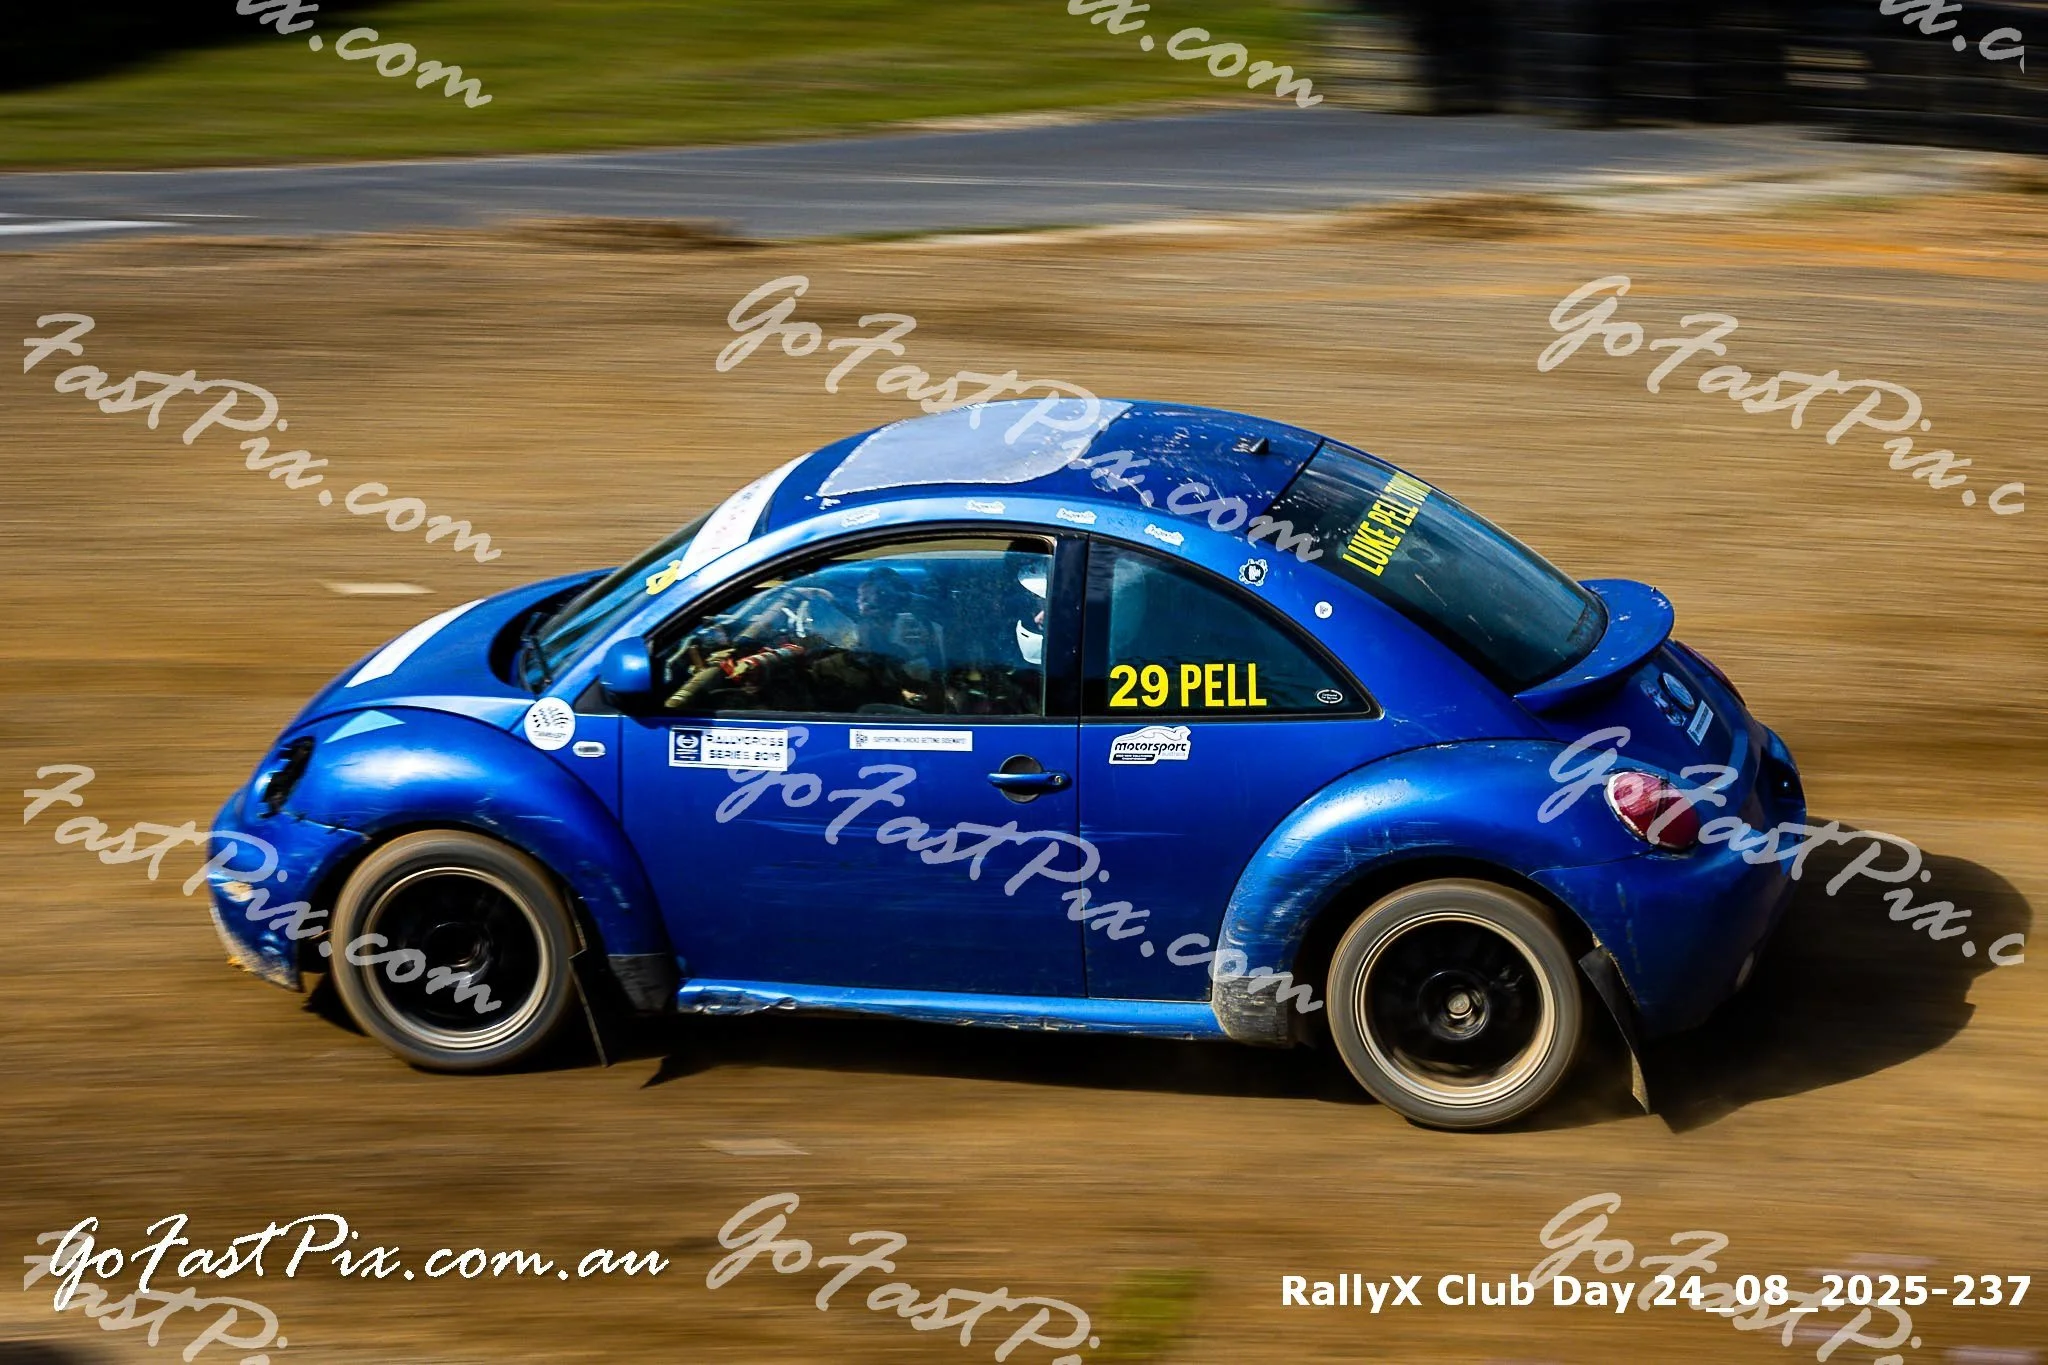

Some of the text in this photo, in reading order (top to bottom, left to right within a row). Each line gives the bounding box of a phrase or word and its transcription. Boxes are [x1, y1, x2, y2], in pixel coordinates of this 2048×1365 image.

[1367, 493, 1419, 535] PELL
[1342, 520, 1402, 577] LUKE
[1109, 663, 1267, 707] 29 PELL
[1114, 742, 1187, 755] motorsport
